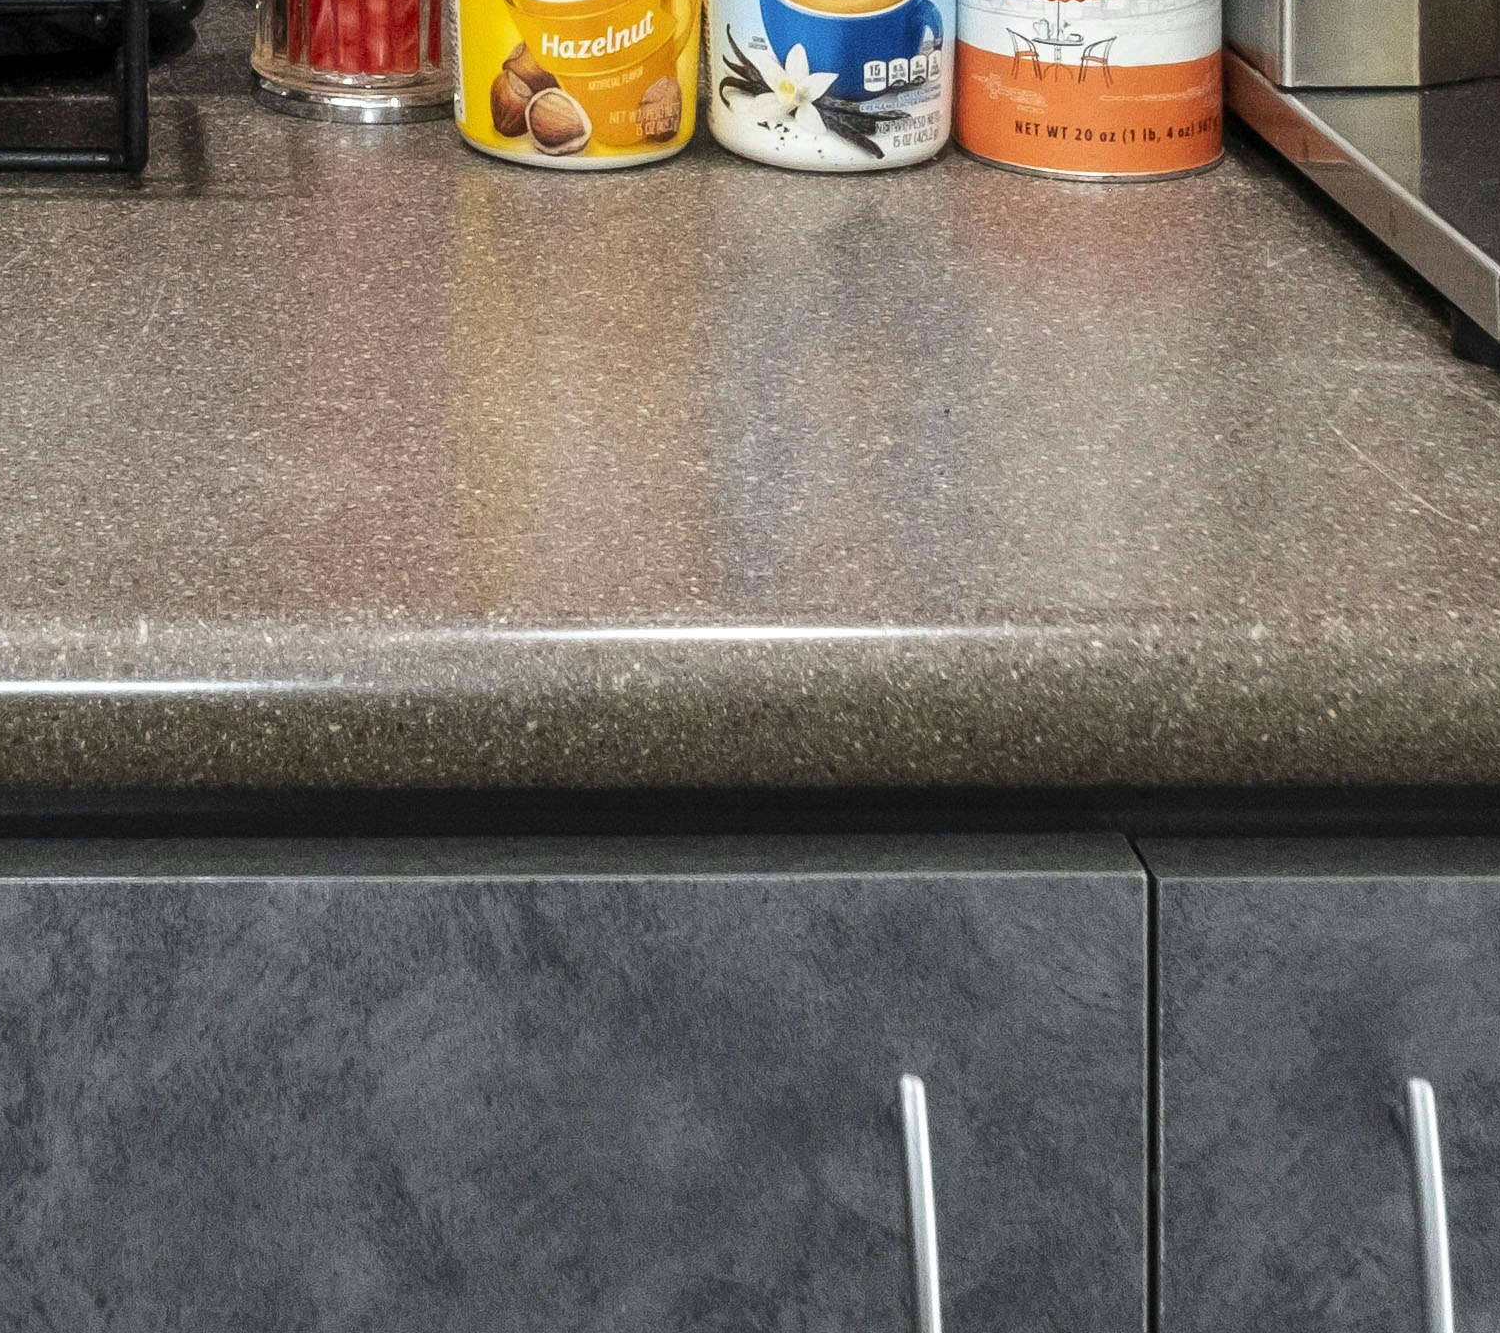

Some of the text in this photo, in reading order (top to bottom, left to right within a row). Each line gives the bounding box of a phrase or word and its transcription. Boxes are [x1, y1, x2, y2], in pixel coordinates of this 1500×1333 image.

[541, 9, 654, 59] Hazelnut
[870, 64, 880, 76] 15
[1015, 120, 1040, 137] NET
[1046, 126, 1068, 139] WT
[1075, 129, 1093, 142] 20
[1100, 131, 1116, 142] oz
[1122, 129, 1135, 144] (1
[1143, 129, 1160, 143] lb,
[1166, 127, 1173, 139] 4
[1178, 125, 1195, 138] oz)
